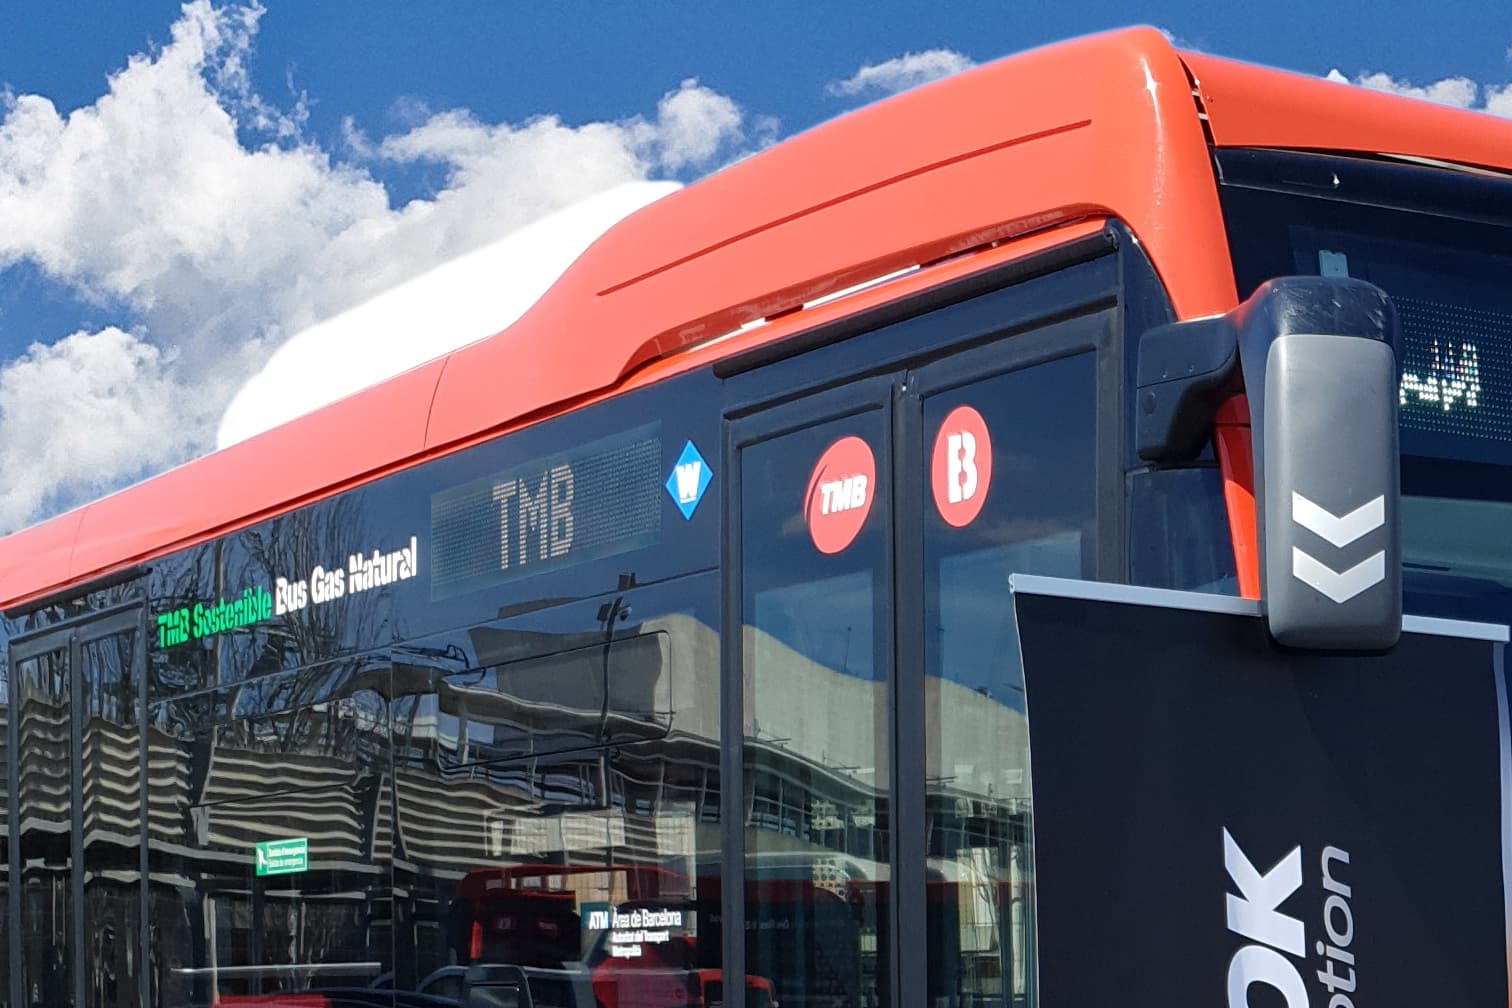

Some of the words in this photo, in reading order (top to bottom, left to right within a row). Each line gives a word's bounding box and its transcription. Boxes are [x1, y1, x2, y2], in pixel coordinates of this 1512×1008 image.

[820, 474, 868, 516] TMB
[947, 431, 978, 504] B
[492, 464, 574, 570] TMB
[157, 608, 190, 648] TMB
[193, 585, 272, 638] Sostenible
[275, 576, 308, 616] Bus
[311, 565, 345, 604] Gas
[349, 536, 417, 594] Natural
[588, 911, 609, 930] ATM
[630, 910, 641, 928] de
[642, 908, 682, 927] Barcelona
